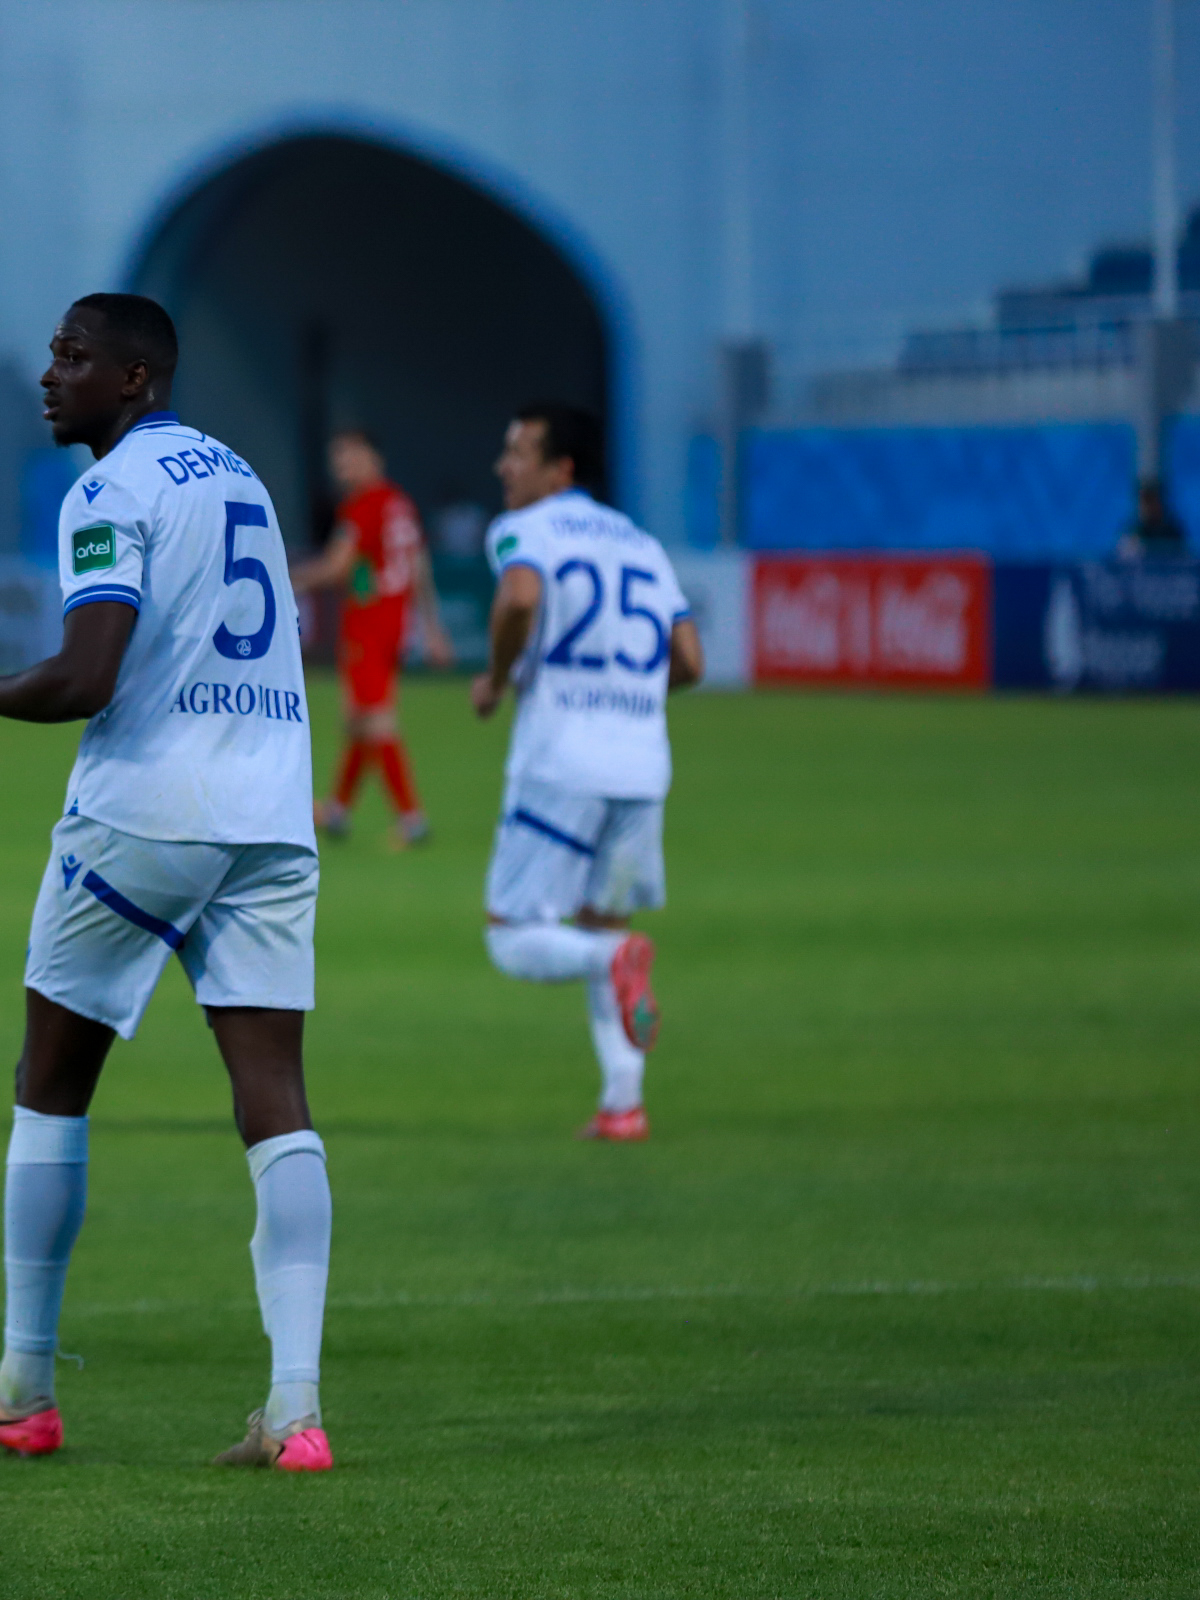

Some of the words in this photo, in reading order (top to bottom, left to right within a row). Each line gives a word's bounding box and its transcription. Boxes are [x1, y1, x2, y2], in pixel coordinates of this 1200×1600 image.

[76, 539, 111, 559] artel
[212, 501, 277, 661] 5
[545, 558, 672, 674] 25
